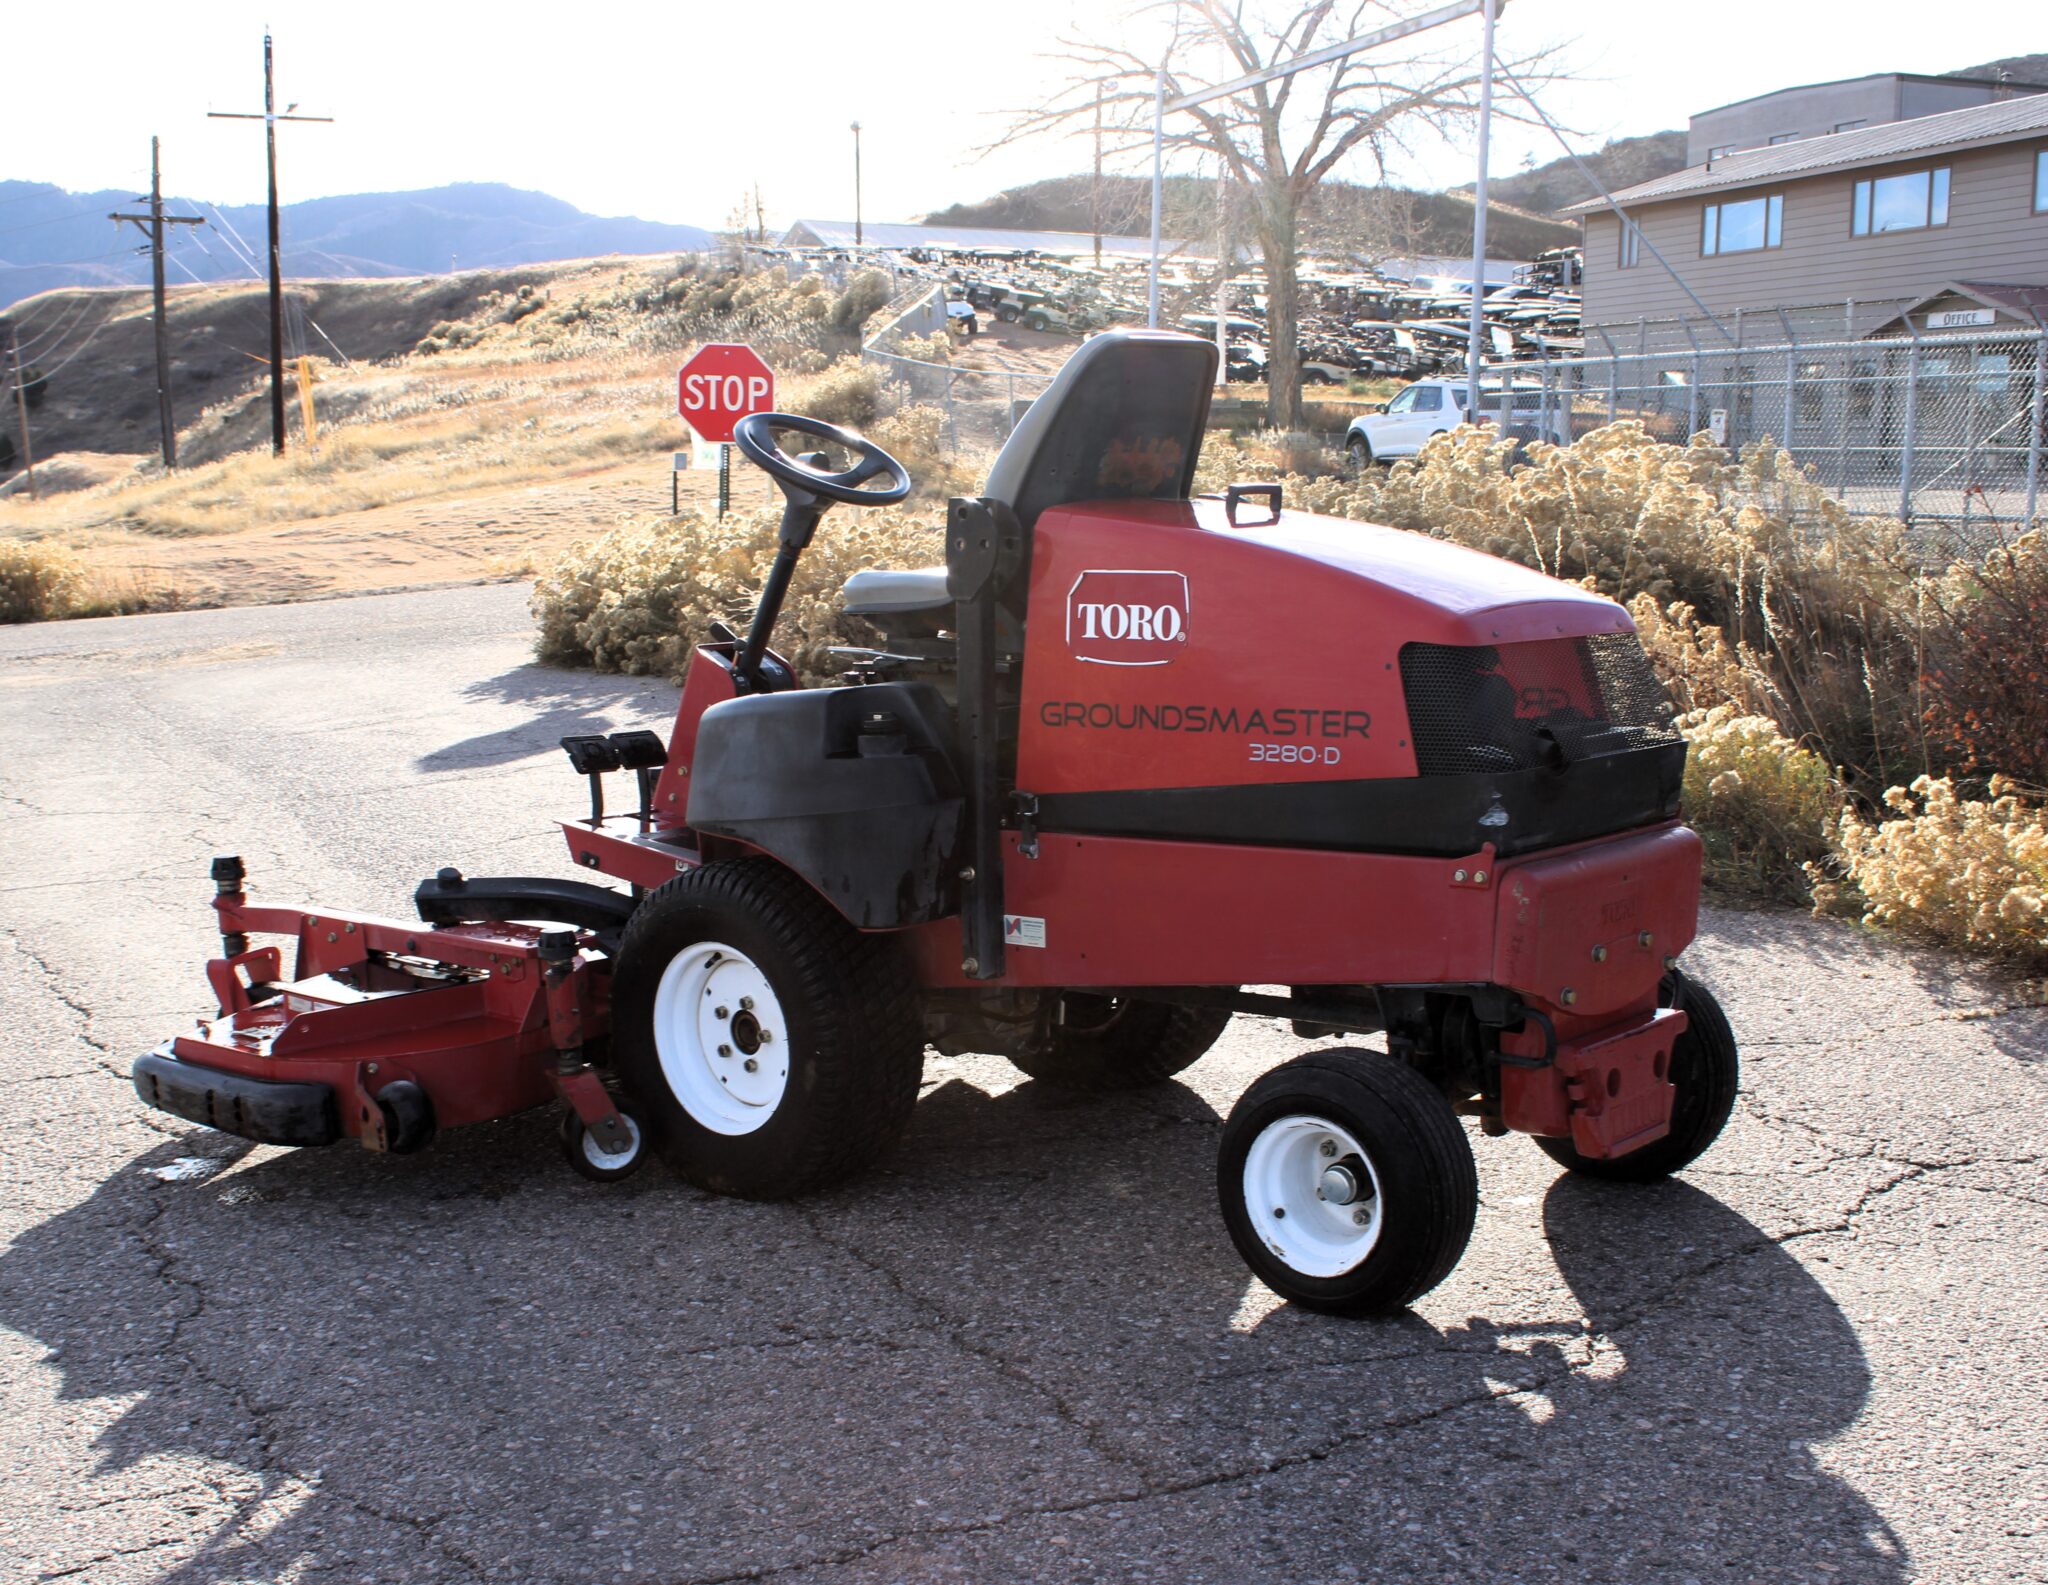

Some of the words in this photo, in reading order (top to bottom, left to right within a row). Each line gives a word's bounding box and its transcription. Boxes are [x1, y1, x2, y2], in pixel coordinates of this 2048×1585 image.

[1943, 313, 1977, 326] OFFICE
[684, 374, 769, 411] STOP
[1078, 603, 1181, 641] TORO
[1040, 701, 1372, 739] GROUNDSMASTER
